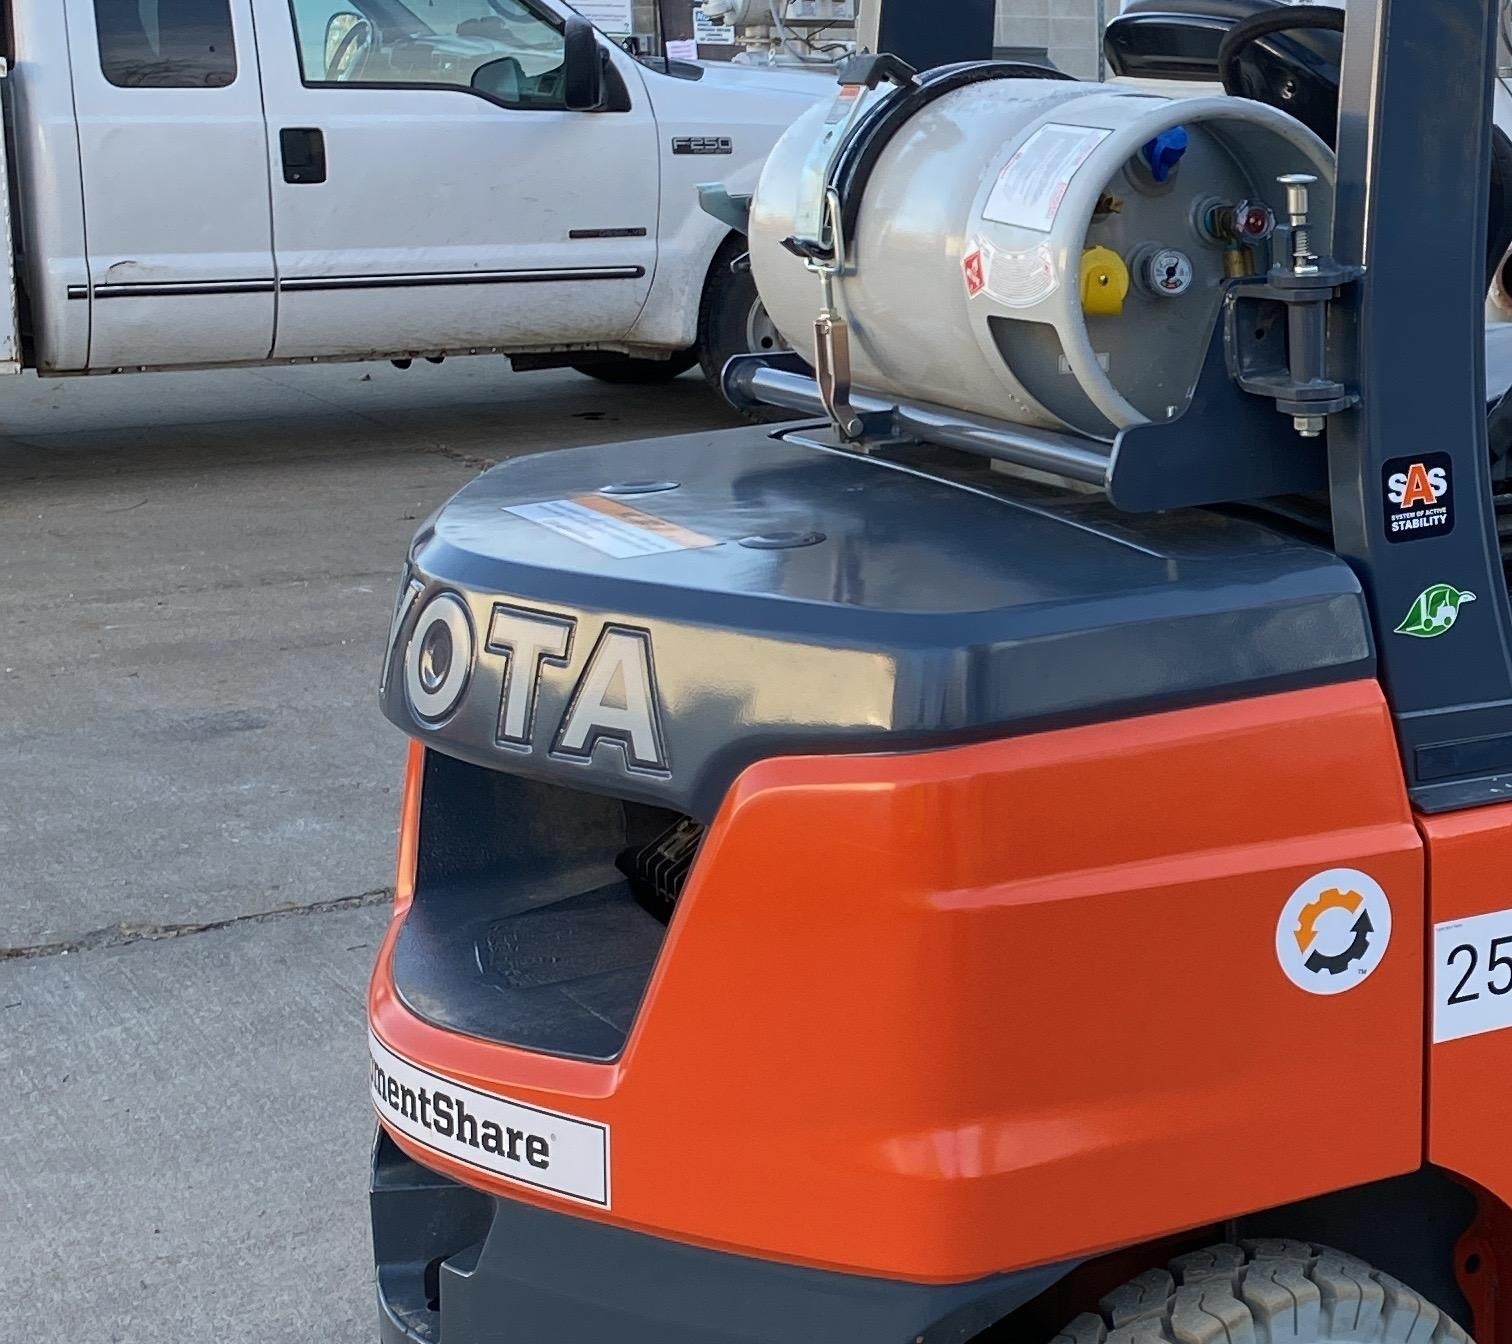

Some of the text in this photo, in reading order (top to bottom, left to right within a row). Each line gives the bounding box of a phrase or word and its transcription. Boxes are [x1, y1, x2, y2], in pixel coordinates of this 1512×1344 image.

[673, 136, 731, 150] F250
[1388, 463, 1448, 509] SAS
[1391, 507, 1447, 521] SYSTEM OF ACTIVE
[1391, 514, 1448, 532] STABILITY
[370, 1058, 550, 1170] mentShare
